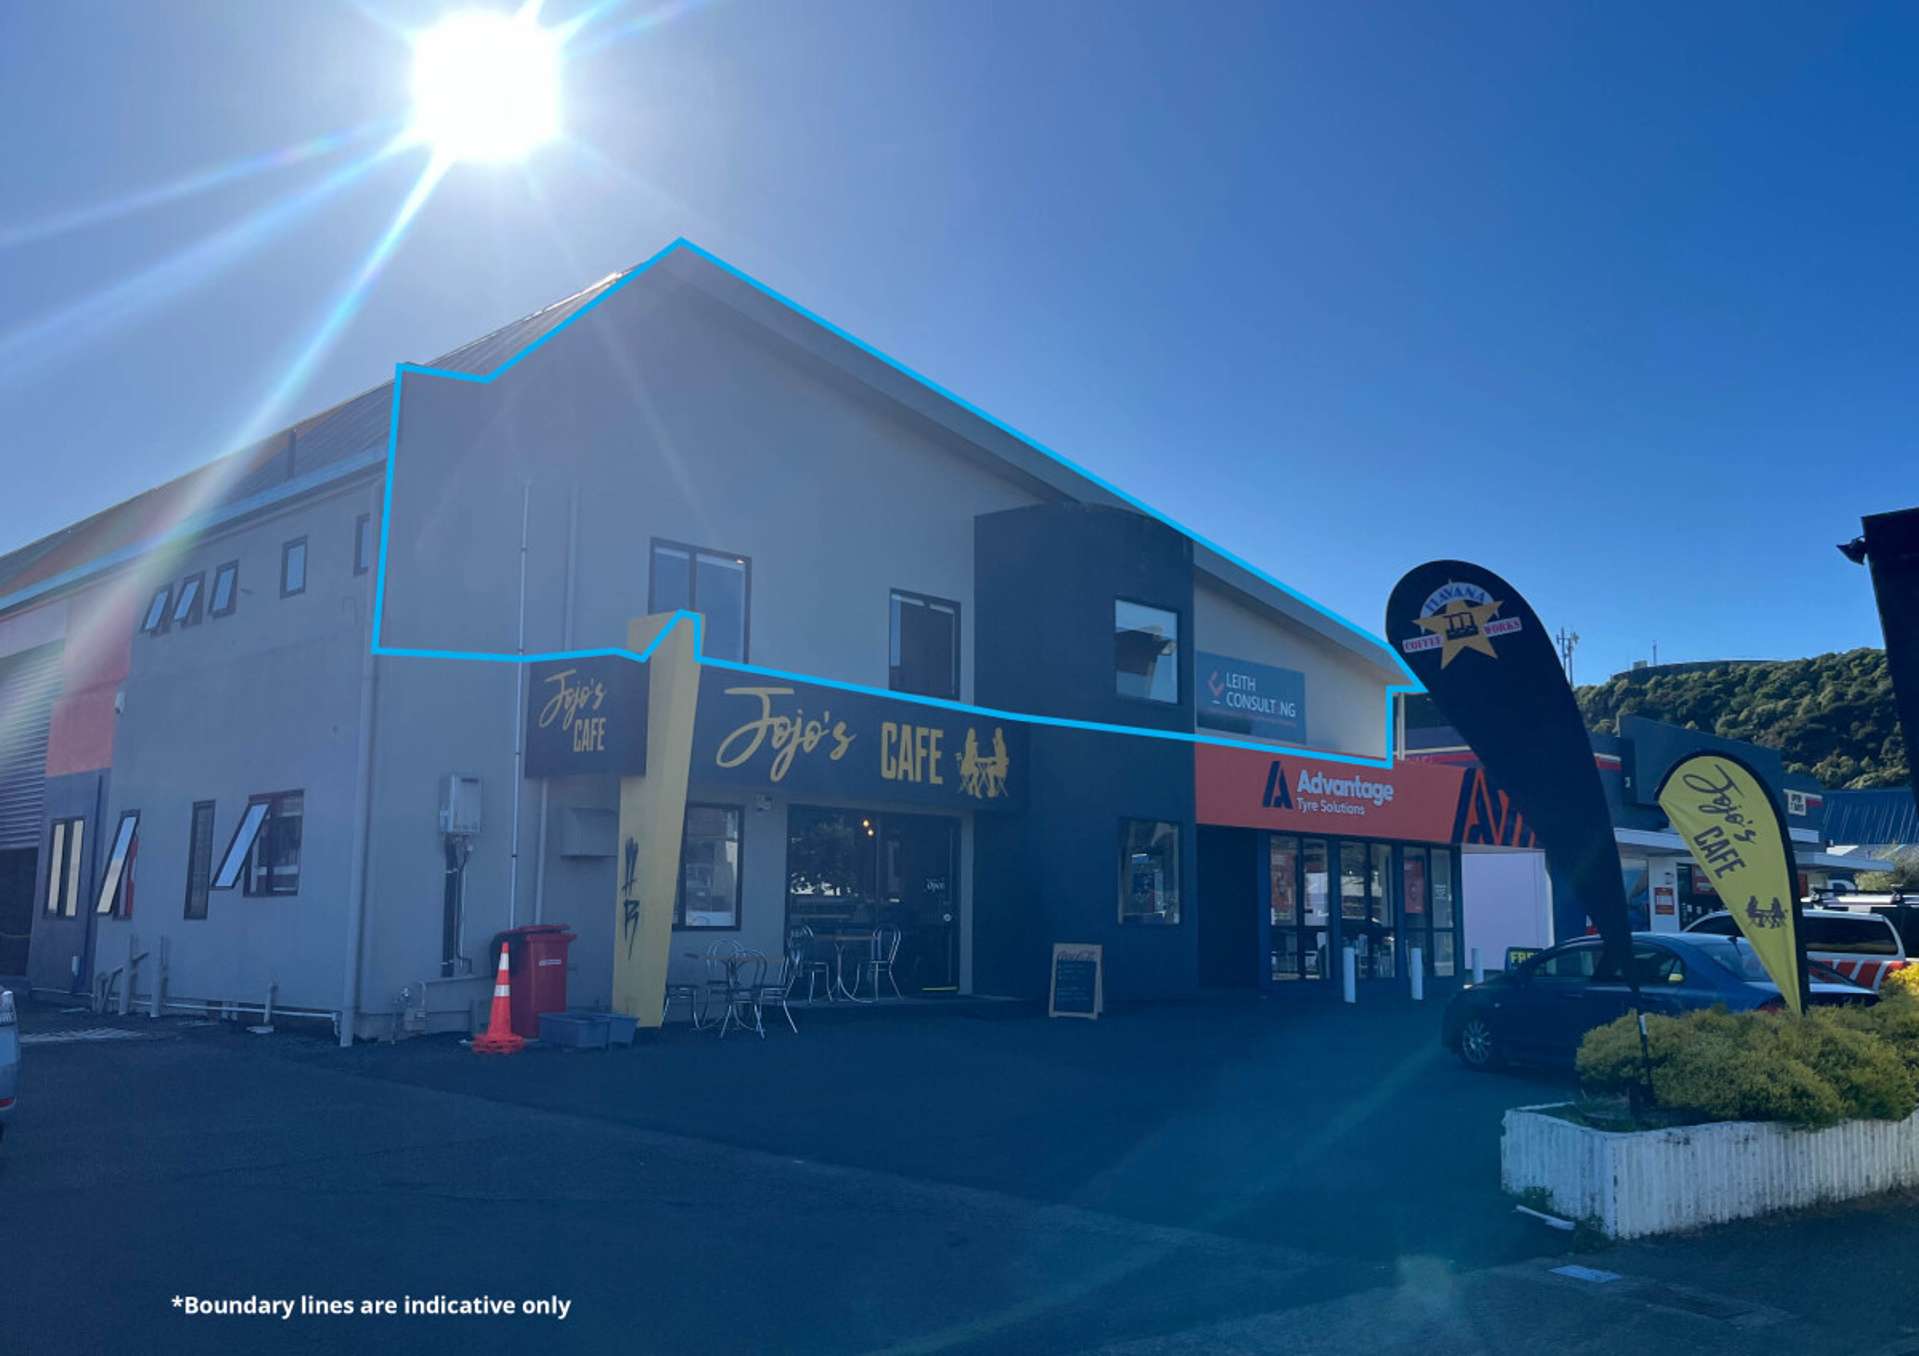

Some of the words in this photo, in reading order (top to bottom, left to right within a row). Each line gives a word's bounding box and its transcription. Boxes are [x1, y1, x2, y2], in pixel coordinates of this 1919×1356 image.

[1424, 586, 1486, 612] HAVANA
[539, 668, 605, 728] Jojo's
[1226, 672, 1257, 692] LEITH
[573, 717, 605, 753] CAFE
[716, 686, 857, 782] Jojo's
[880, 722, 943, 785] CAFE
[1296, 769, 1393, 806] Advantage
[1296, 797, 1318, 814] Tyre
[1320, 799, 1366, 815] Solutions
[1683, 764, 1756, 843] Jojo's
[1694, 825, 1746, 879] CAFE
